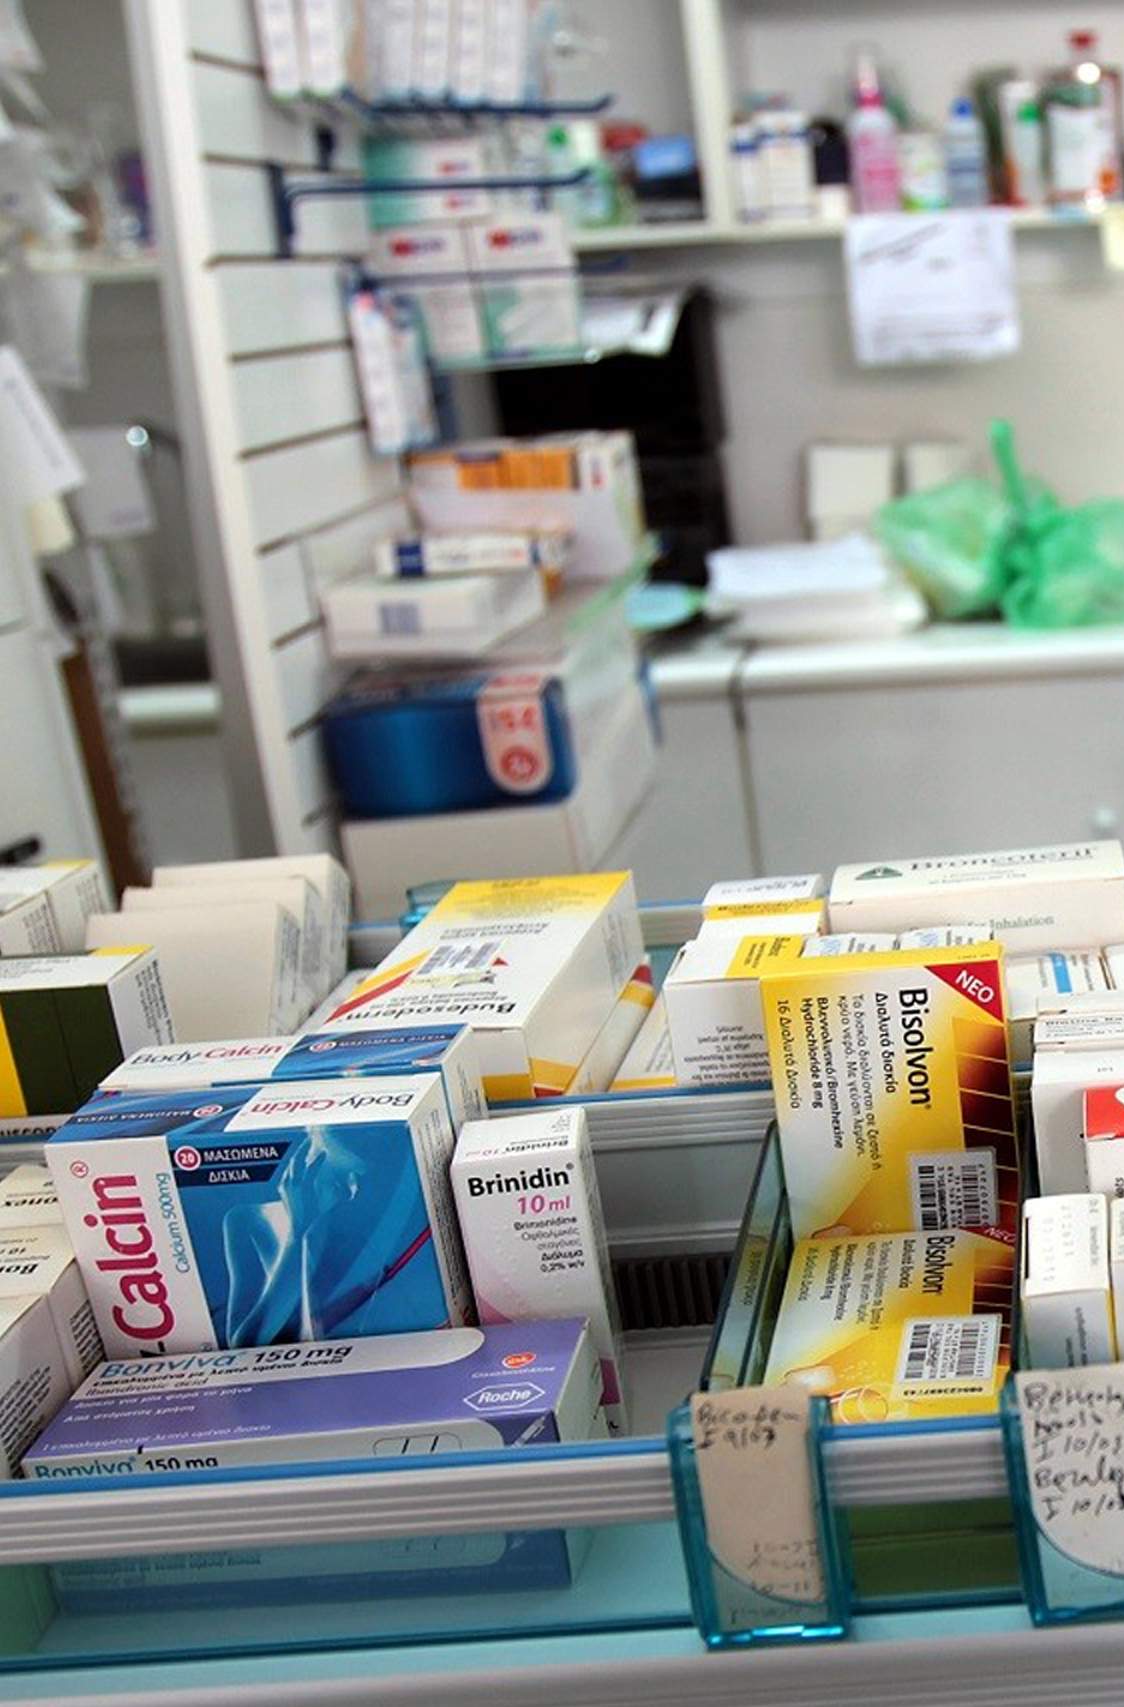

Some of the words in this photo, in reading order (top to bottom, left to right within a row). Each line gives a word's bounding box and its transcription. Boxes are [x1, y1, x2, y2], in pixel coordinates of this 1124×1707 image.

[990, 913, 1055, 931] Inhalation
[955, 970, 995, 1004] NEO
[346, 1001, 516, 1021] Budesoderm
[777, 999, 790, 1014] 16
[875, 992, 894, 1047] Διαλυτά
[131, 1050, 201, 1065] Body
[204, 1043, 283, 1061] Calcin
[800, 997, 820, 1079] Hydrochloride
[811, 1089, 824, 1109] mg
[898, 988, 934, 1106] Bisolvon
[251, 1098, 336, 1114] Calcin
[338, 1094, 414, 1109] Body
[180, 1152, 196, 1165] 20
[203, 1147, 279, 1163] ΜΑΣΩΜΕΝΑ
[208, 1169, 250, 1183] ΔΙΣΚΙΑ
[468, 1167, 570, 1197] Brinidin
[518, 1194, 545, 1215] 10
[548, 1195, 571, 1211] ml
[84, 1175, 176, 1341] Calcin
[921, 1235, 956, 1295] Bisolvon
[99, 1354, 236, 1379] Bonviva
[252, 1348, 301, 1364] 150
[304, 1345, 353, 1359] mg
[477, 1389, 532, 1404] Roche
[34, 1459, 133, 1479] Bonviva
[145, 1456, 180, 1472] 150
